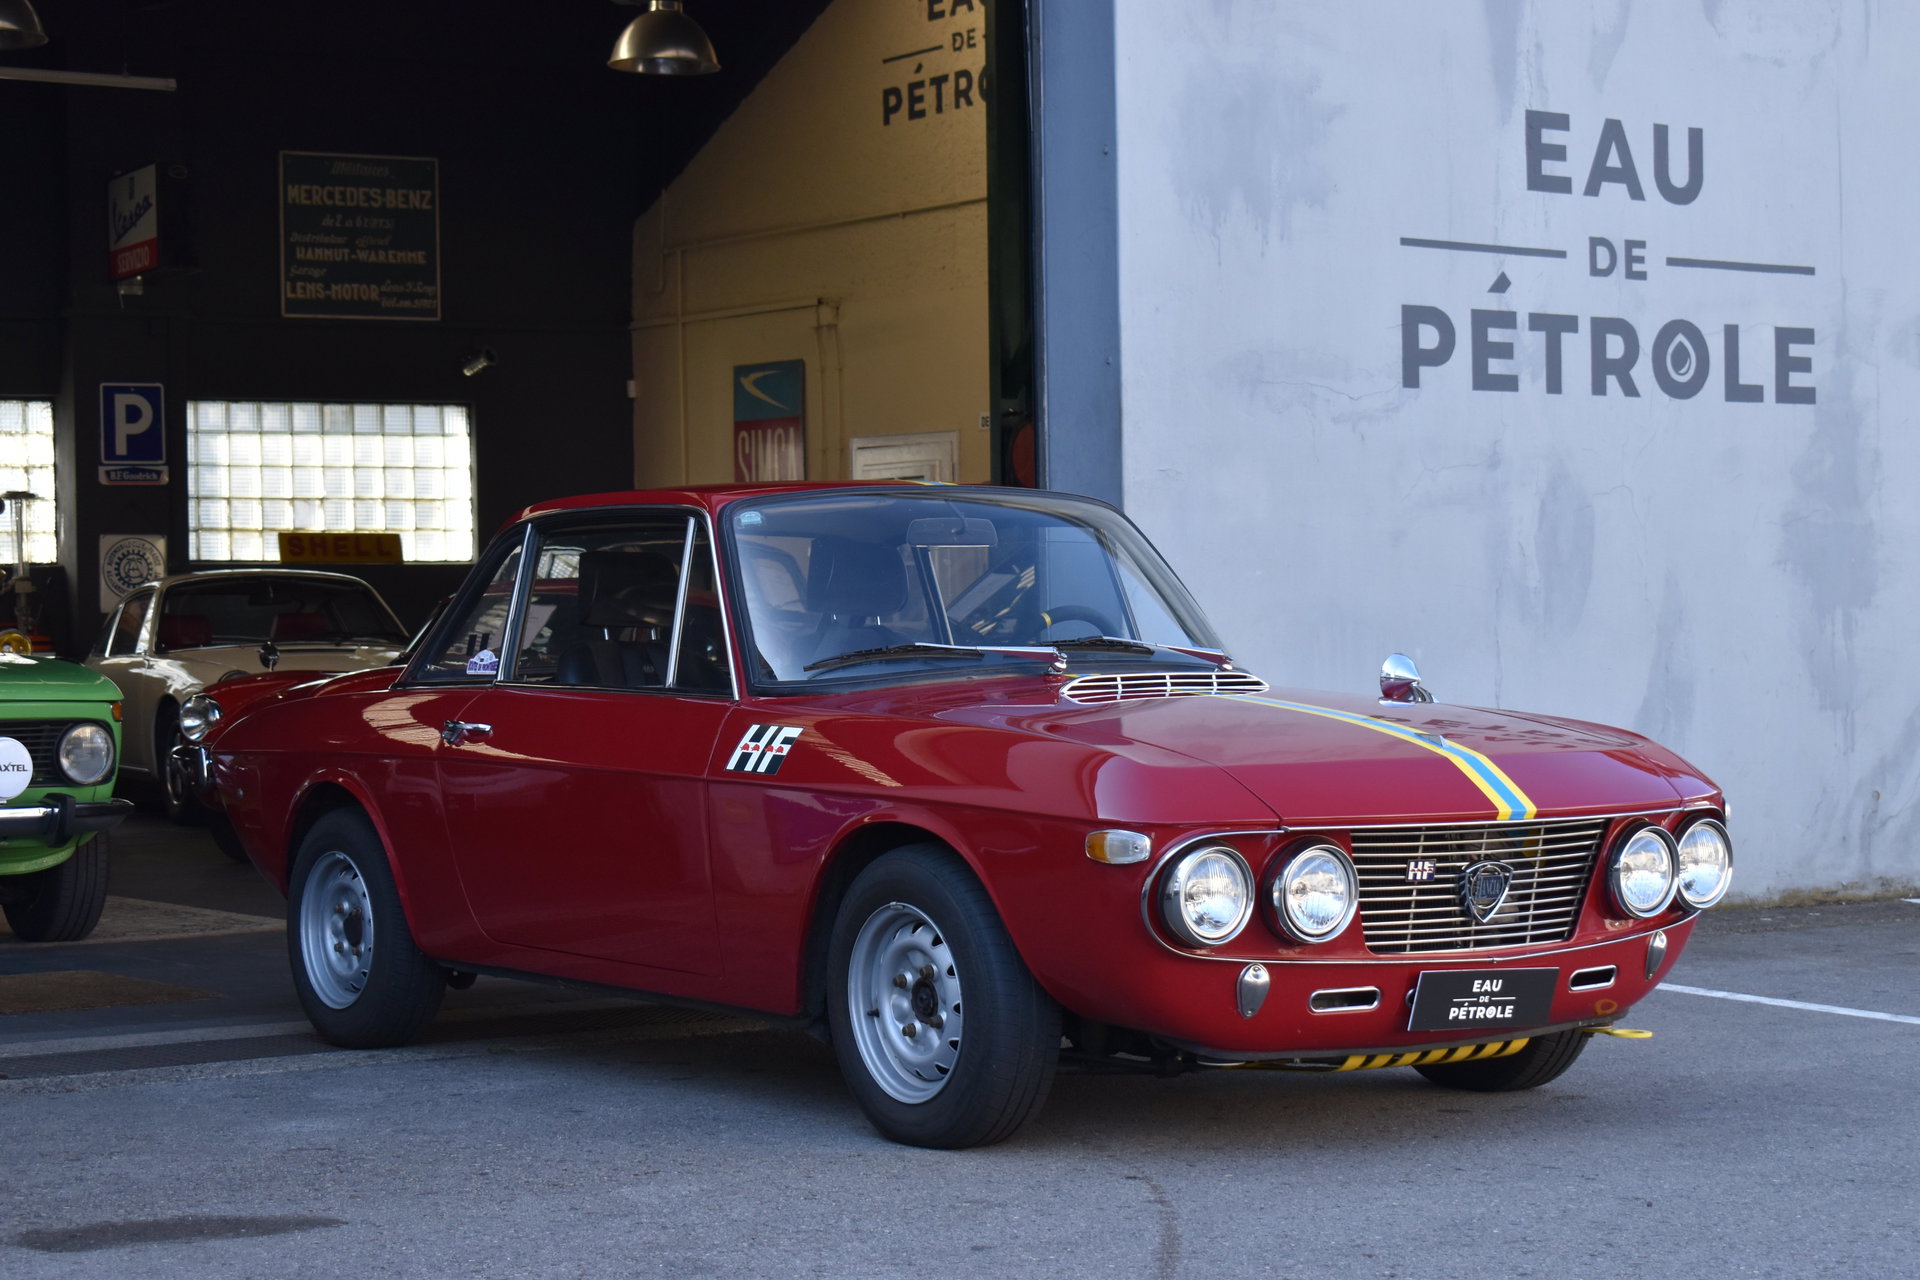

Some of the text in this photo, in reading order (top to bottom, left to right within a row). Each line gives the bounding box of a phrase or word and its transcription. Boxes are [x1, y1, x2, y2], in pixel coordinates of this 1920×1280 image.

[928, 0, 986, 21] EA
[952, 28, 977, 52] DE
[1525, 109, 1704, 206] EAU
[287, 184, 433, 210] MERCEDES-BENZ
[112, 194, 153, 245] Vespa
[117, 246, 150, 274] SERVIZIO
[1589, 236, 1647, 281] DE
[286, 281, 380, 302] LENS-MOTOR
[1401, 271, 1816, 405] PÉTROLE
[114, 393, 153, 456] P
[288, 535, 392, 556] SHELL
[726, 724, 804, 773] HF
[1408, 861, 1434, 880] HF
[1472, 979, 1503, 992] EAU
[1449, 1002, 1514, 1020] PÉTROLE
